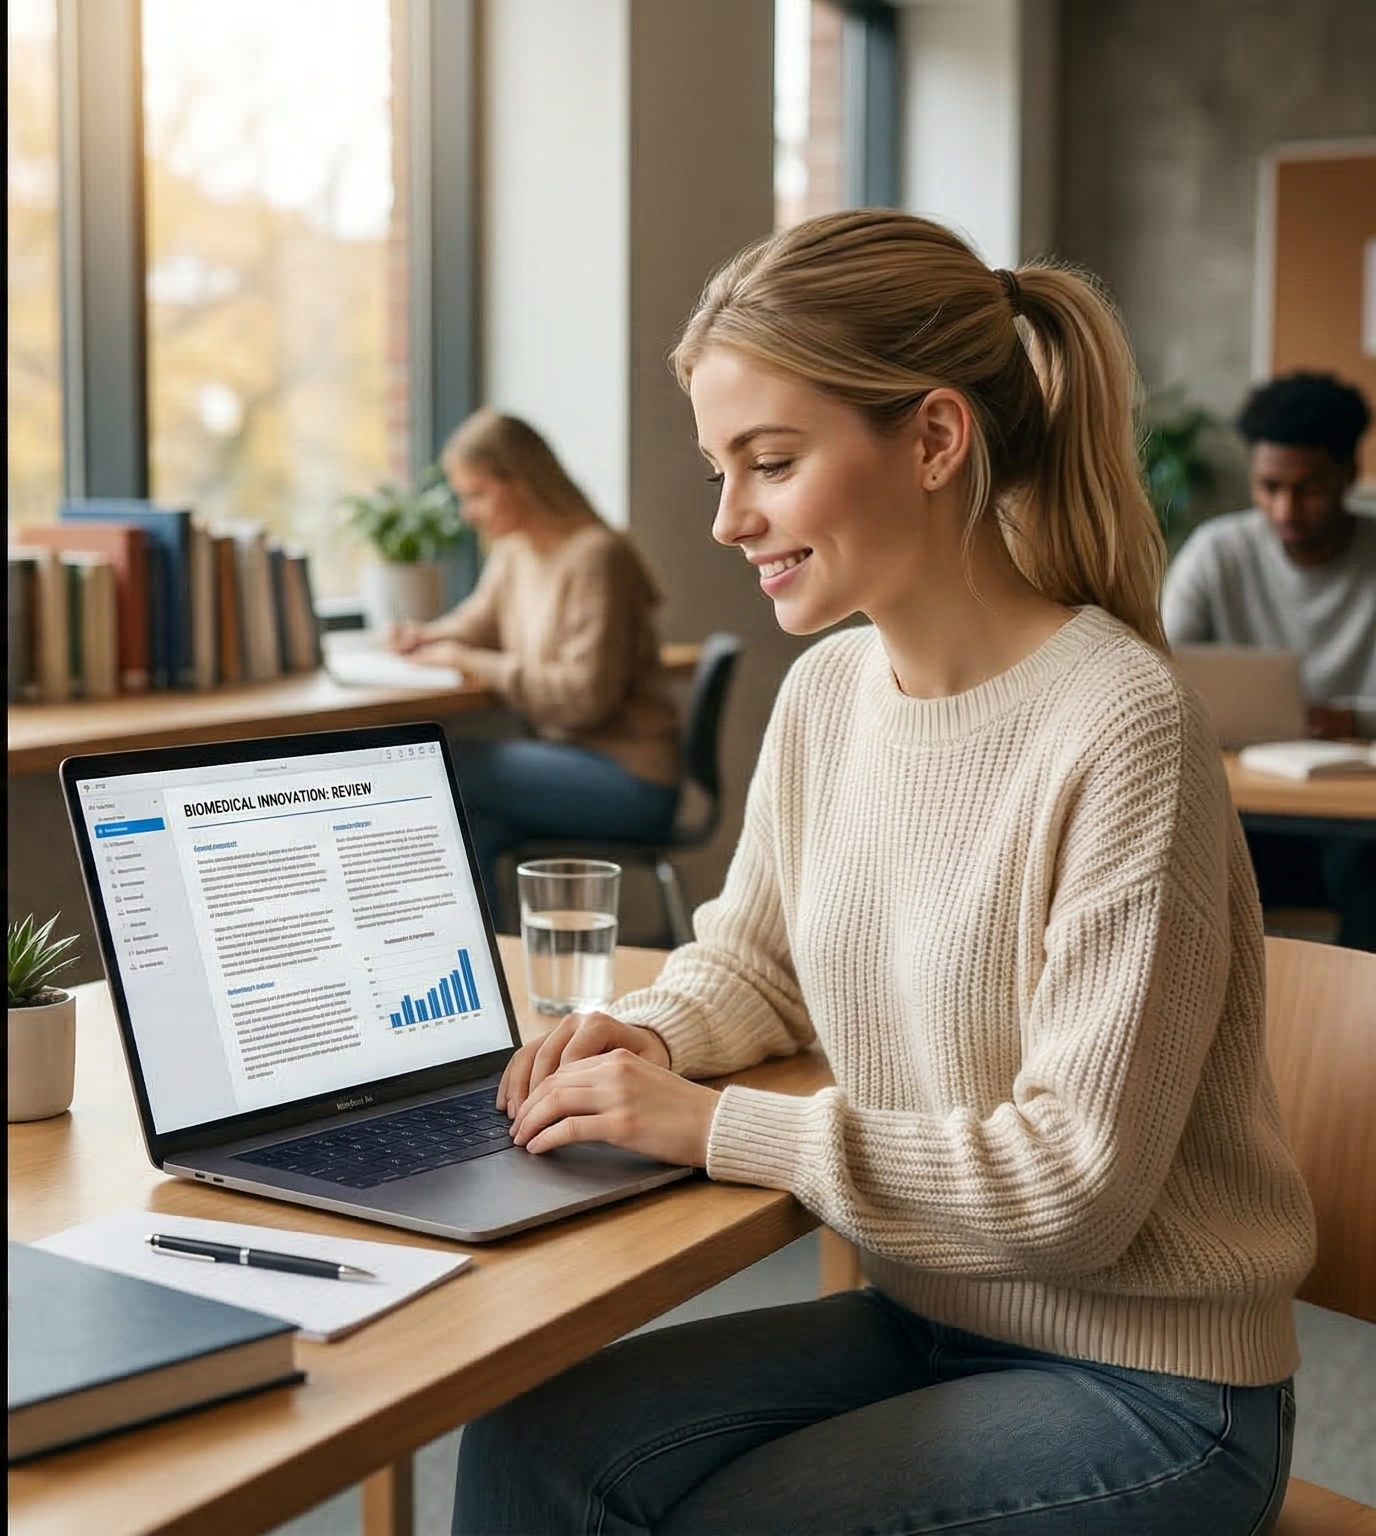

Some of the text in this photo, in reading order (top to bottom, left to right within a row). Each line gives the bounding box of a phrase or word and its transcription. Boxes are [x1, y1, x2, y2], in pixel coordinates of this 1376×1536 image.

[184, 782, 372, 818] BIOMEDICAL INNOVATION: REVIEW
